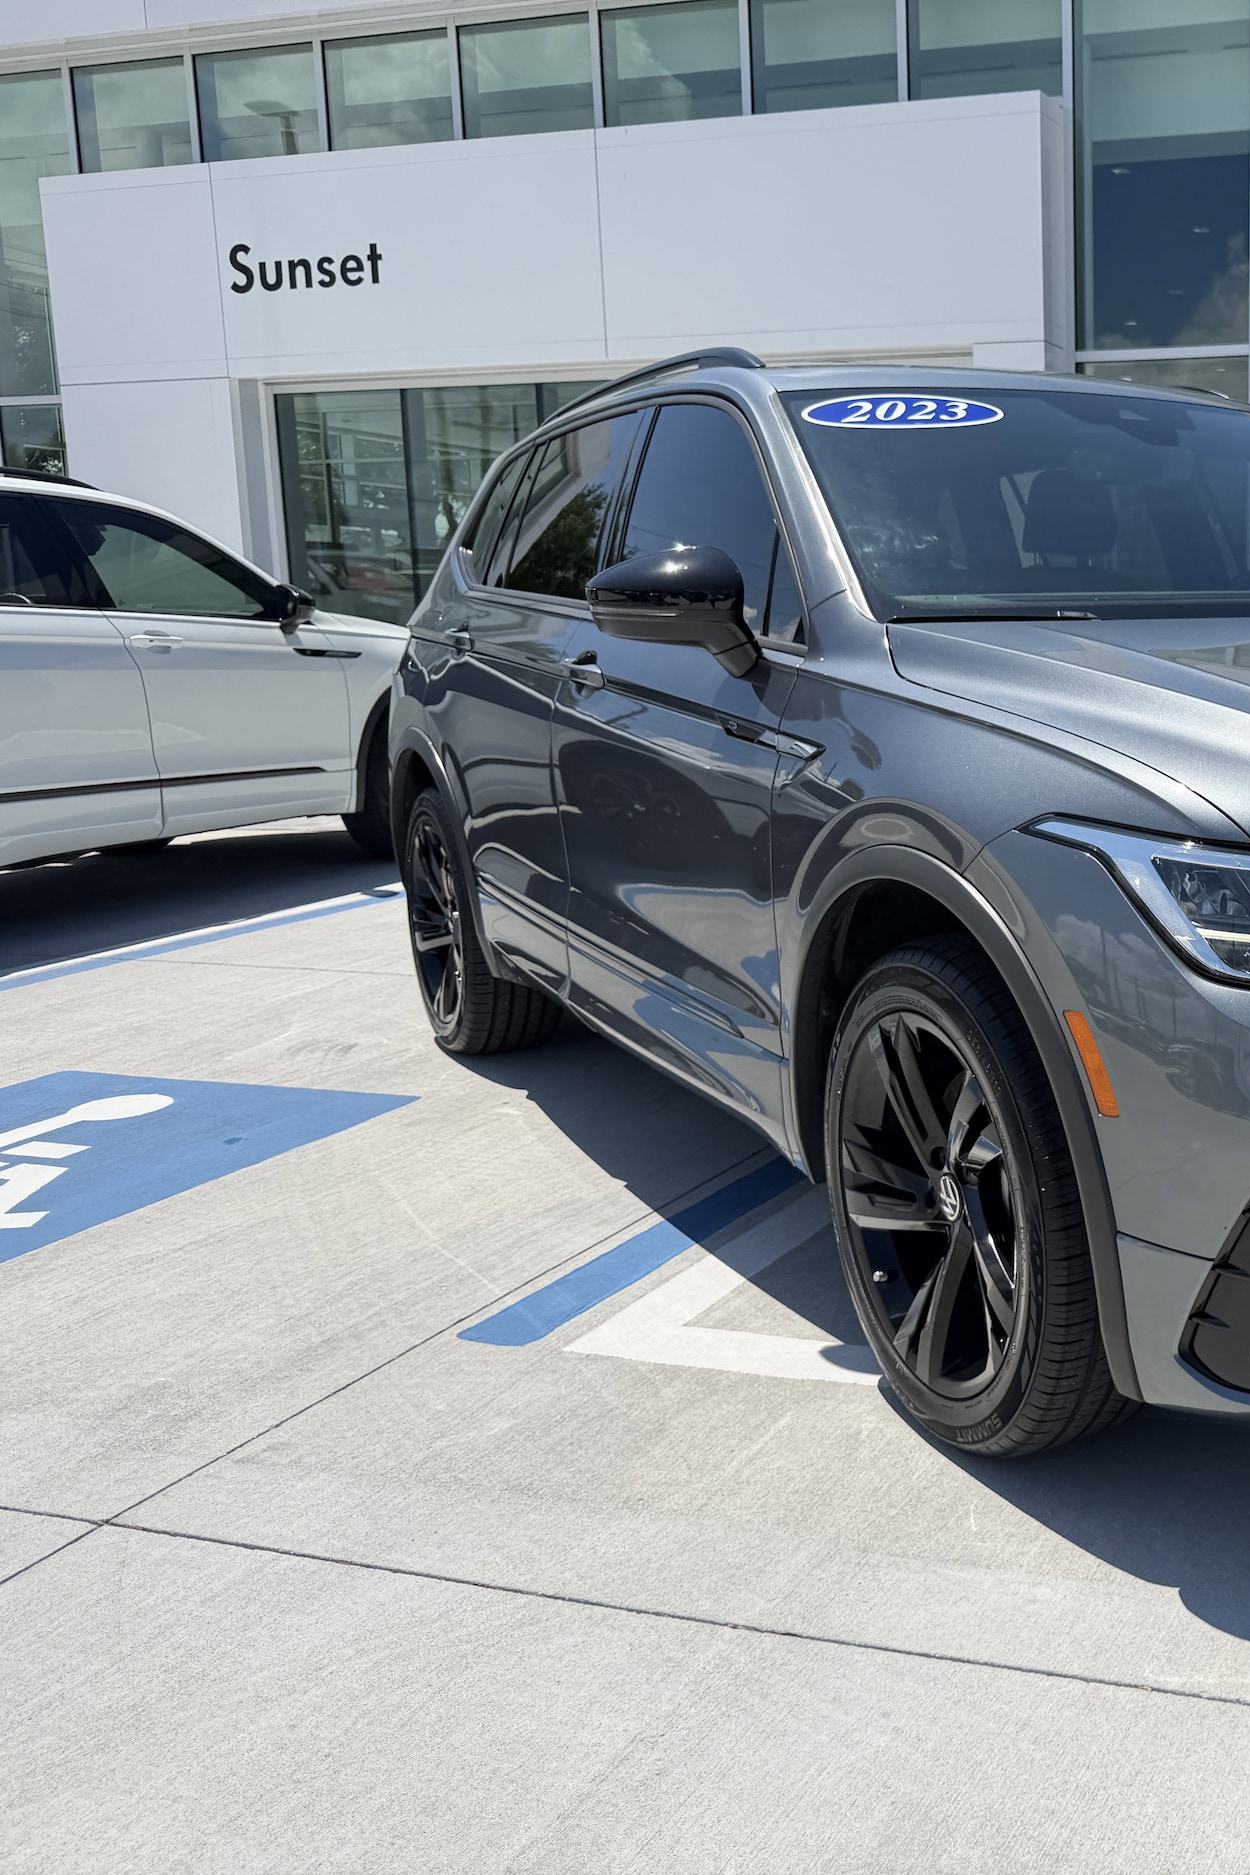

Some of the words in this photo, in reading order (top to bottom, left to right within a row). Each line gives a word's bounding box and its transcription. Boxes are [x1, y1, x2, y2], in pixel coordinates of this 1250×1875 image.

[229, 243, 382, 294] Sunset
[841, 401, 969, 423] 2023
[956, 1413, 1002, 1442] SUMMIT
